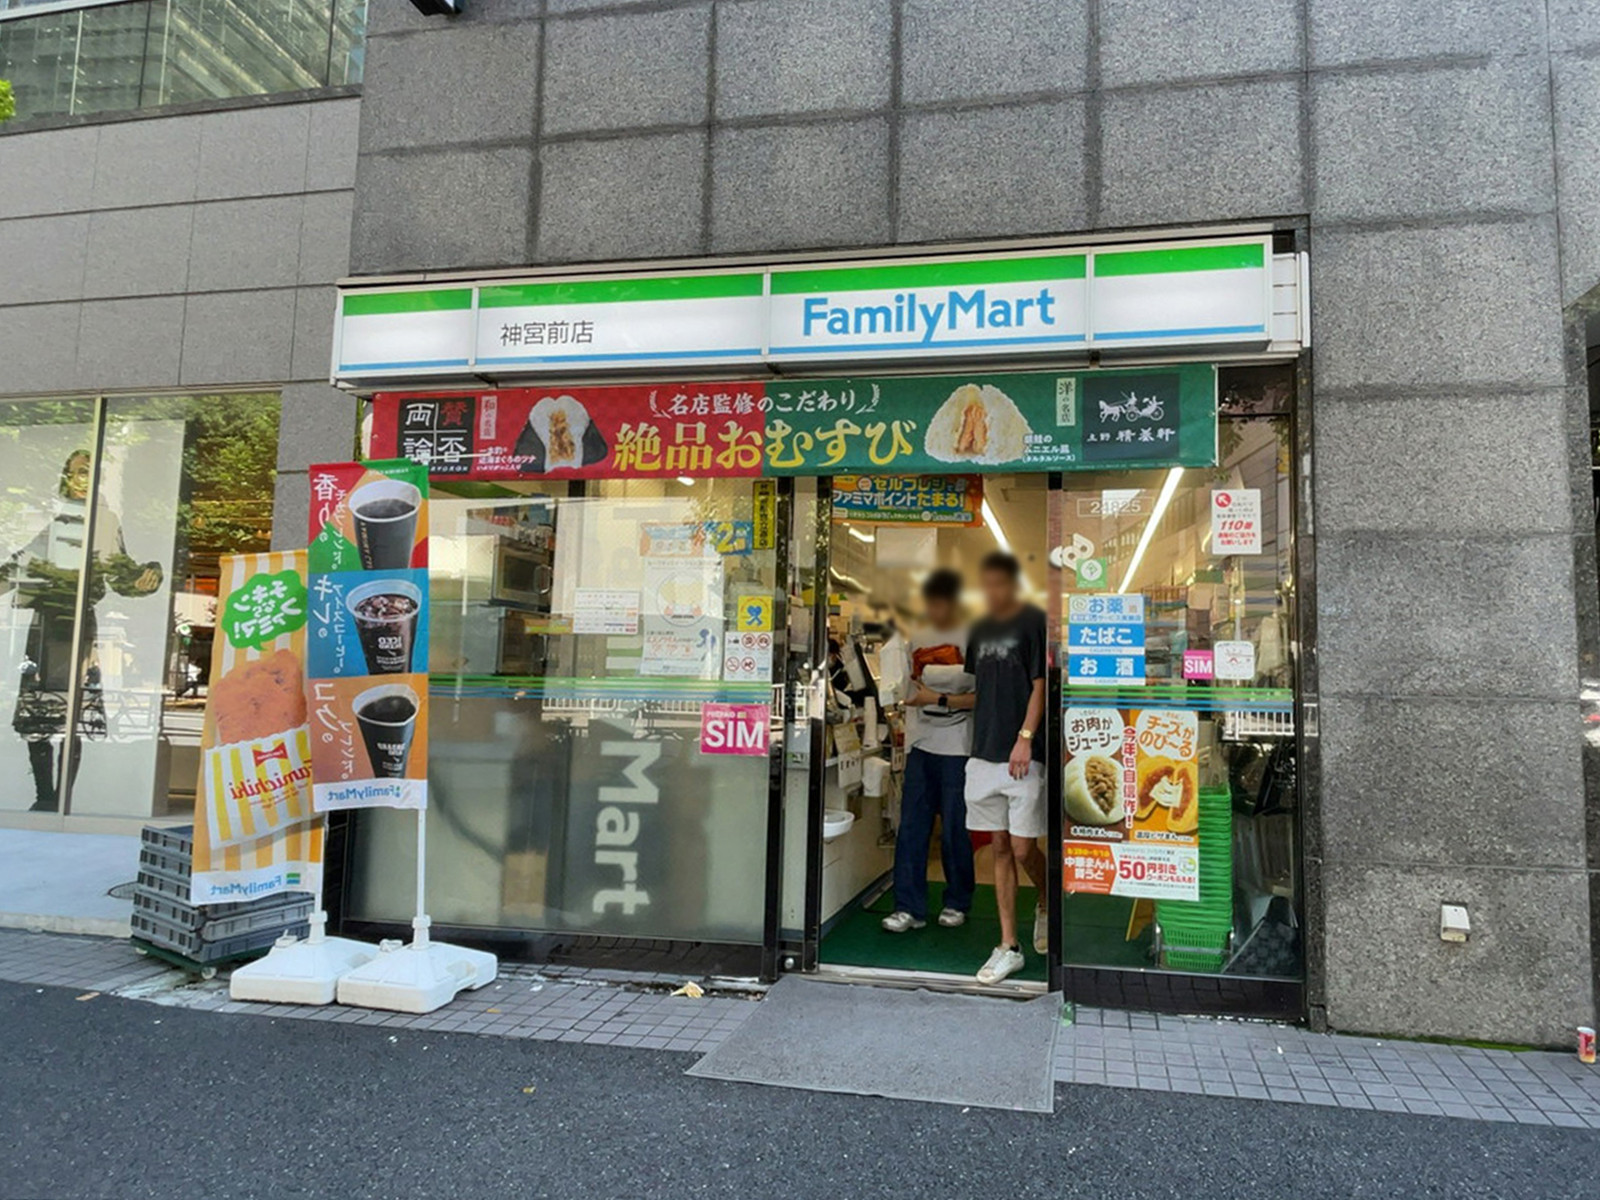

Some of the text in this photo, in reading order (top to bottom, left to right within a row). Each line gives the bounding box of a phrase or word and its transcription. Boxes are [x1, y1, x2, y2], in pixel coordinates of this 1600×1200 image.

[803, 287, 1055, 343] FamilyMart
[500, 320, 593, 346] 神宮前店
[667, 389, 856, 417] 名店監修のこだわり
[612, 418, 918, 472] 絶品おむすび
[1088, 598, 1124, 614] お薬
[1080, 626, 1132, 645] たばこ
[1079, 657, 1134, 676] お酒
[1184, 660, 1212, 674] SIM
[705, 719, 765, 749] SIM
[1071, 716, 1113, 734] お肉が
[1147, 715, 1195, 739] チーズが
[1068, 733, 1120, 752] ジューシー
